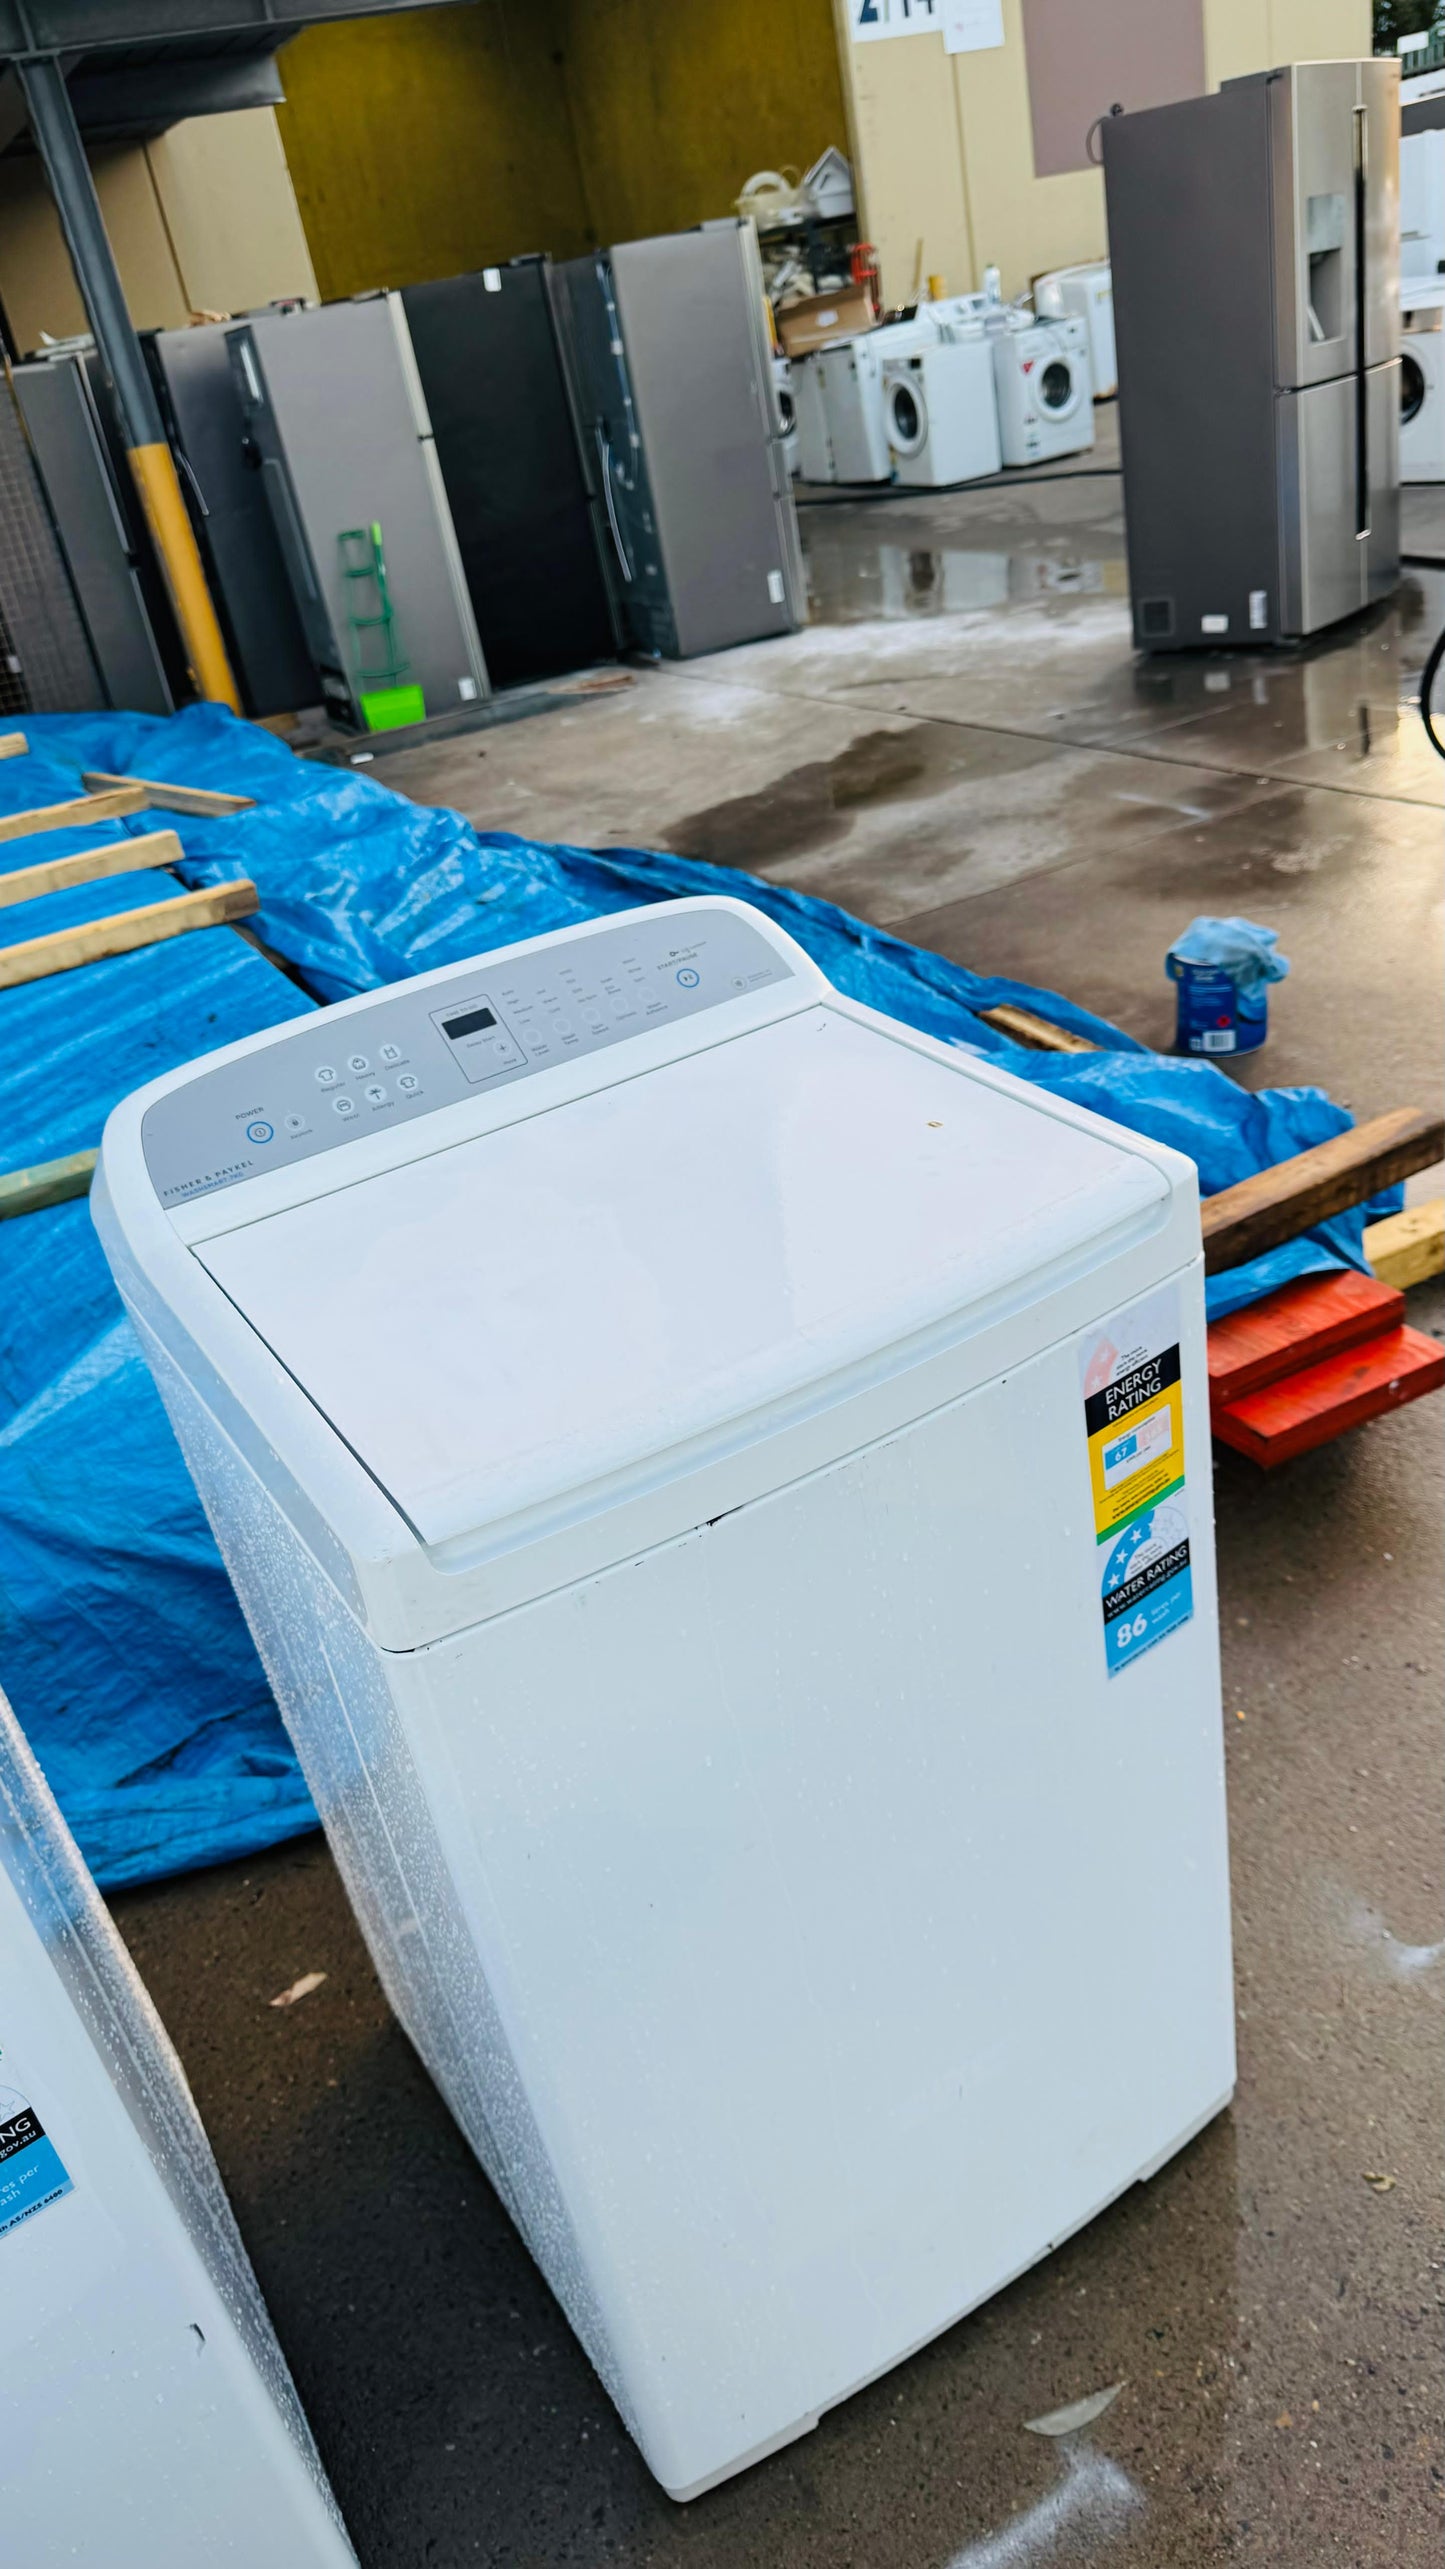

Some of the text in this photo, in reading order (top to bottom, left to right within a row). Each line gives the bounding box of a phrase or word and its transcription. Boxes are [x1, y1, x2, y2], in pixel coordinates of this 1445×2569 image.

[235, 1106, 264, 1120] POWER
[163, 1178, 201, 1196] FISHER
[215, 1160, 253, 1177] PAYKEL
[1105, 1358, 1161, 1405] ENERGY
[1108, 1377, 1161, 1421] RATING
[1115, 1446, 1128, 1462] 67
[1105, 1576, 1146, 1608] WATER
[1146, 1545, 1187, 1580] RATING
[1116, 1612, 1148, 1648] 86
[19, 2165, 39, 2184] per
[9, 2202, 42, 2227] AS/NZS
